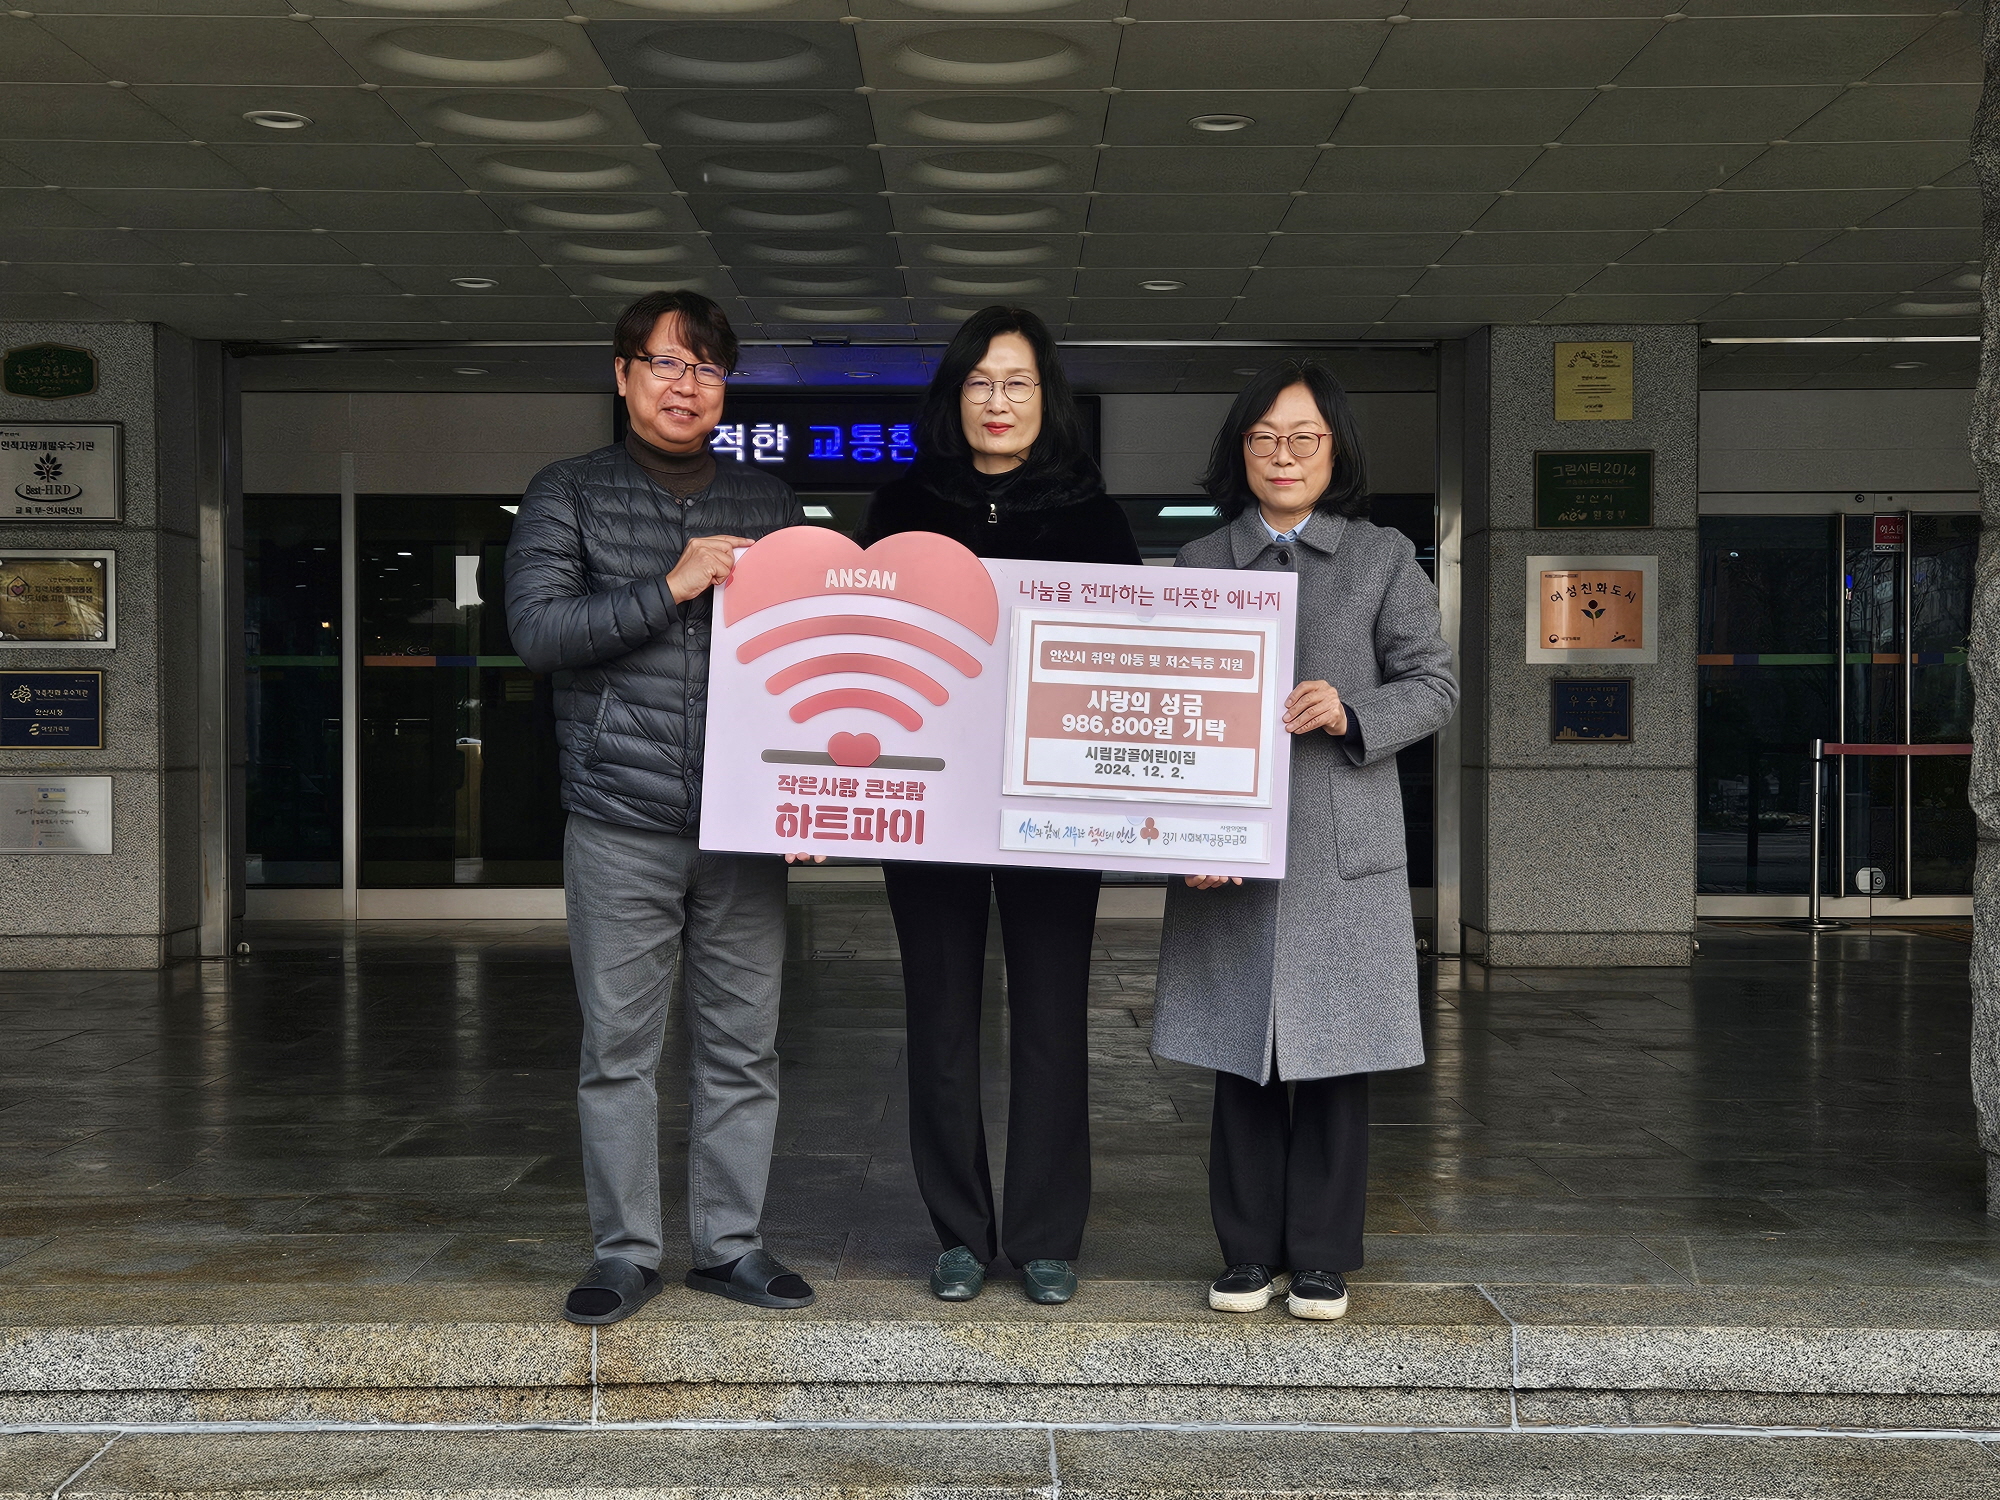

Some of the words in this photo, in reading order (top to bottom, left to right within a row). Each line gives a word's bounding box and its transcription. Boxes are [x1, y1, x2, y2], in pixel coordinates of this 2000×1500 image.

[709, 423, 789, 462] 적한
[825, 568, 897, 591] ANSAN
[1019, 580, 1073, 603] 나눔을
[1080, 582, 1155, 607] 전파하는
[1163, 586, 1220, 609] 따뜻한
[1226, 589, 1282, 612] 에너지
[1550, 582, 1637, 604] 여성친화도시
[1049, 649, 1087, 665] 안산시
[1091, 651, 1116, 665] 취약
[1120, 653, 1145, 667] 아동
[1149, 654, 1162, 668] 및
[1219, 658, 1244, 672] 지원
[1086, 689, 1151, 715] 사랑의
[1159, 692, 1204, 718] 성금
[1061, 714, 1174, 740] 986,800원
[1182, 718, 1227, 743] 기탁
[1085, 745, 1197, 766] 시립감골어린이집
[1094, 763, 1136, 778] 2024.
[1142, 765, 1165, 779] 12.
[1170, 766, 1185, 780] 2.
[777, 774, 860, 798] 작은사랑
[864, 778, 927, 802] 큰보람
[775, 802, 926, 846] 하트파이
[1116, 826, 1137, 844] 안산
[1162, 831, 1178, 846] 경기
[1179, 832, 1248, 848] 사회복지공동모금회
